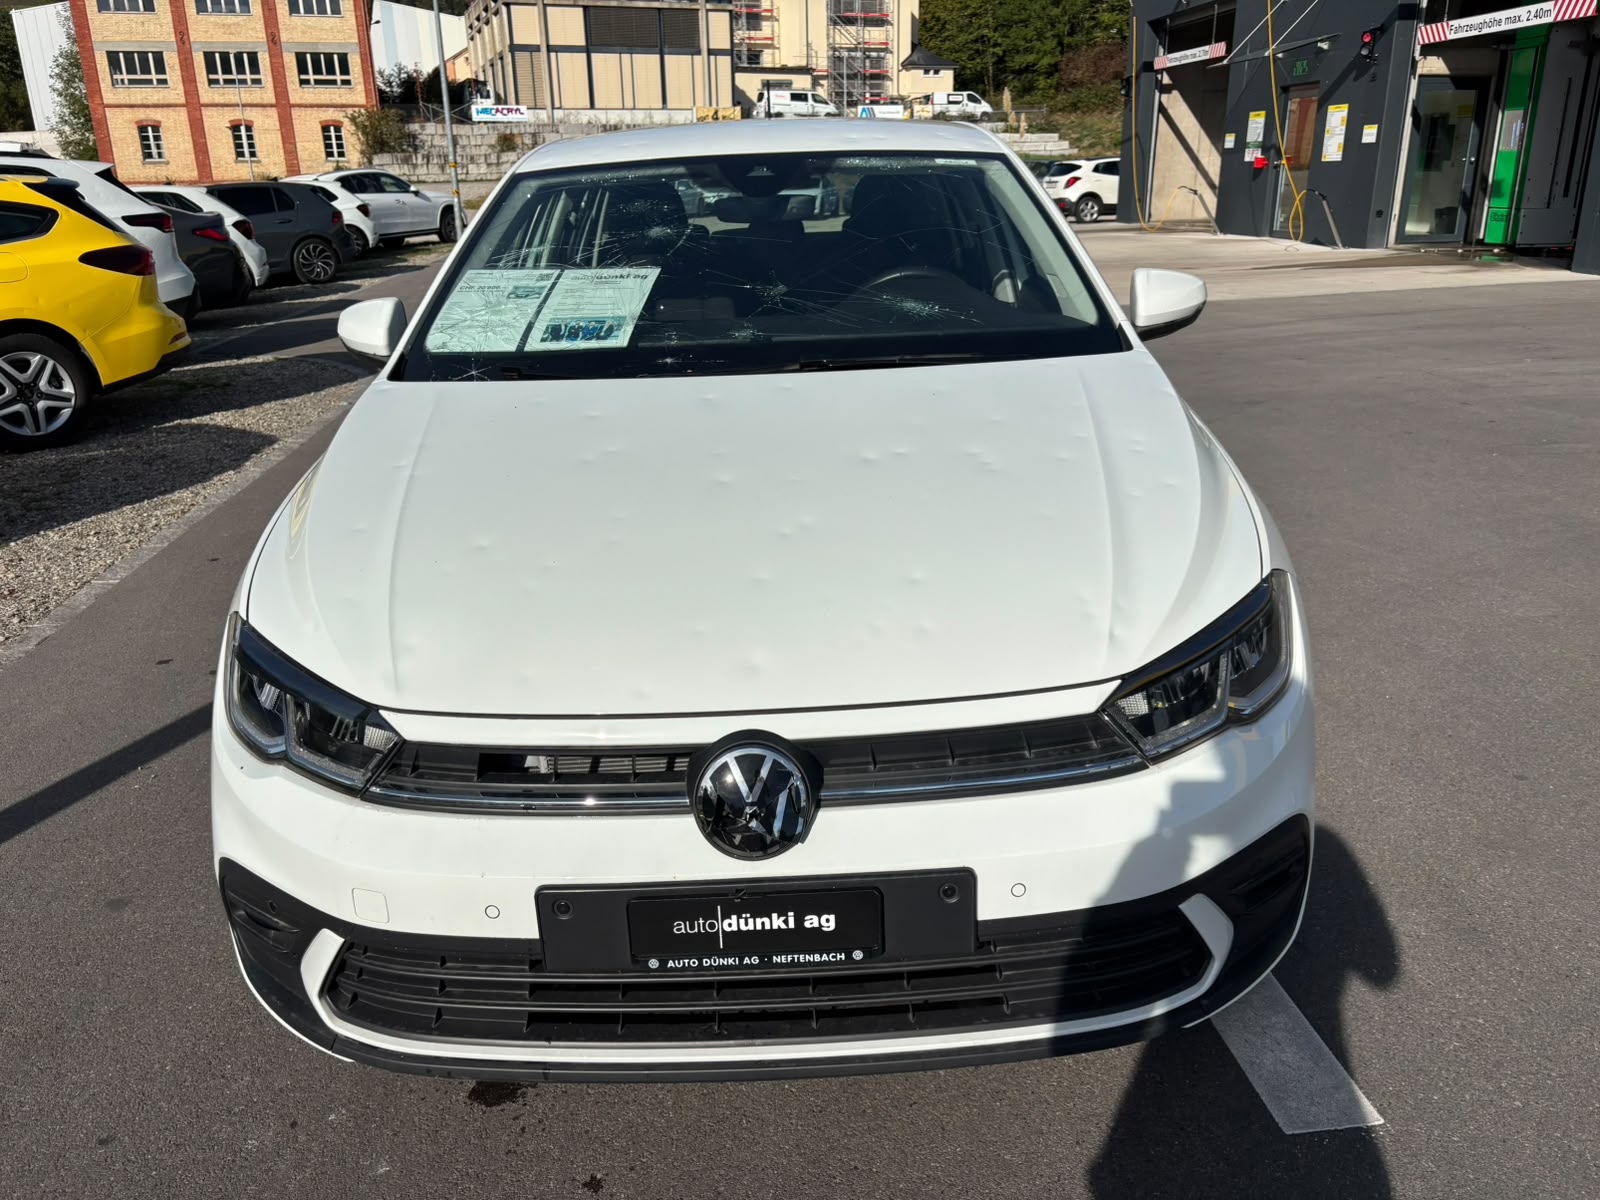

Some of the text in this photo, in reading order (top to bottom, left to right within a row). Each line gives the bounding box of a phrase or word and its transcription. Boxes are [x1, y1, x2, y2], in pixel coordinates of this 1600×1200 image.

[1449, 7, 1552, 35] Fahrzeughöhe max. 2.40m
[723, 911, 795, 932] dünki
[803, 913, 836, 931] ag
[667, 958, 699, 968] AUTO
[702, 956, 739, 967] DÜNKI
[743, 956, 760, 965] AG
[772, 952, 845, 964] NEFTENBACH
